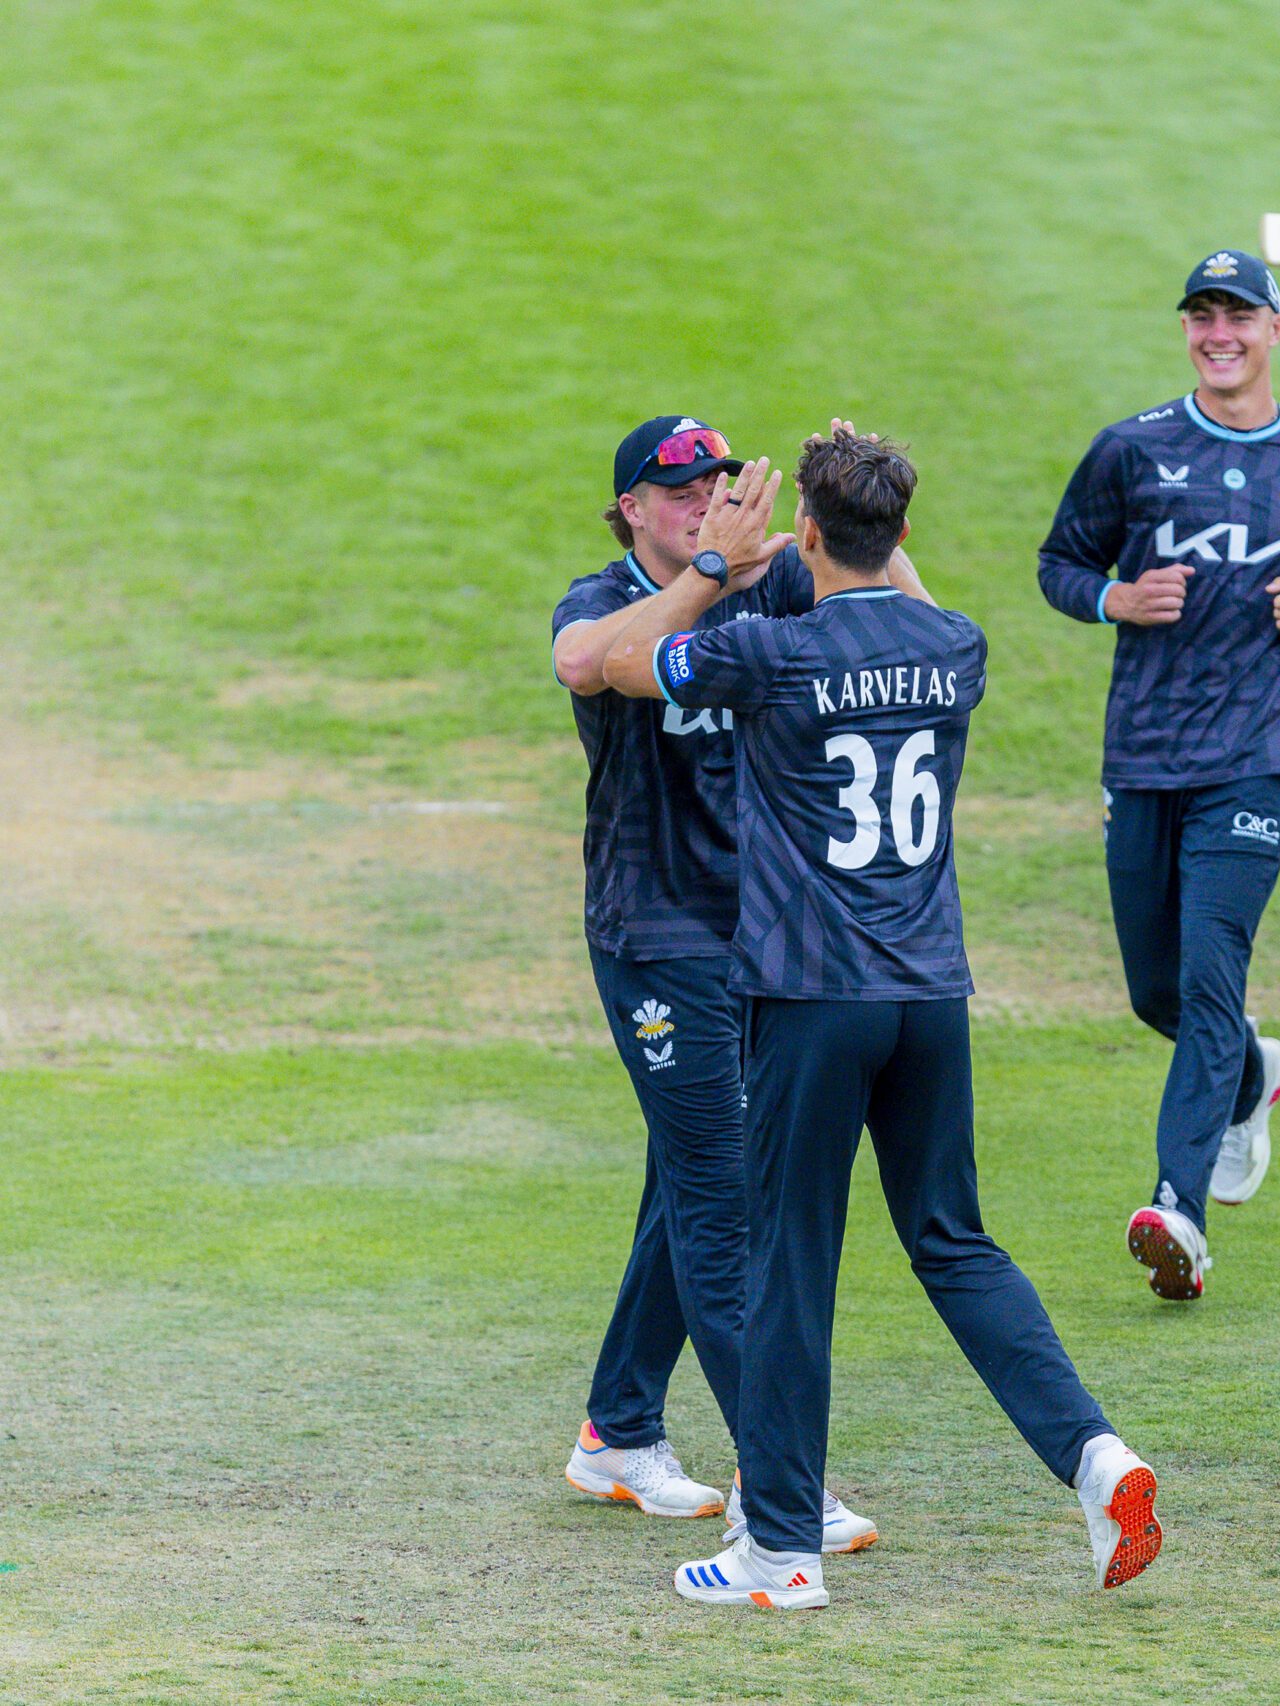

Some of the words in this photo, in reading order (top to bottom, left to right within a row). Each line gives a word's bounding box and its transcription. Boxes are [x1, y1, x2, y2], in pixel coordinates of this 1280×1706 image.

[668, 648, 681, 682] BANK
[813, 666, 957, 714] KARVELAS
[825, 730, 940, 870] 36
[649, 1060, 676, 1072] CASTORE
